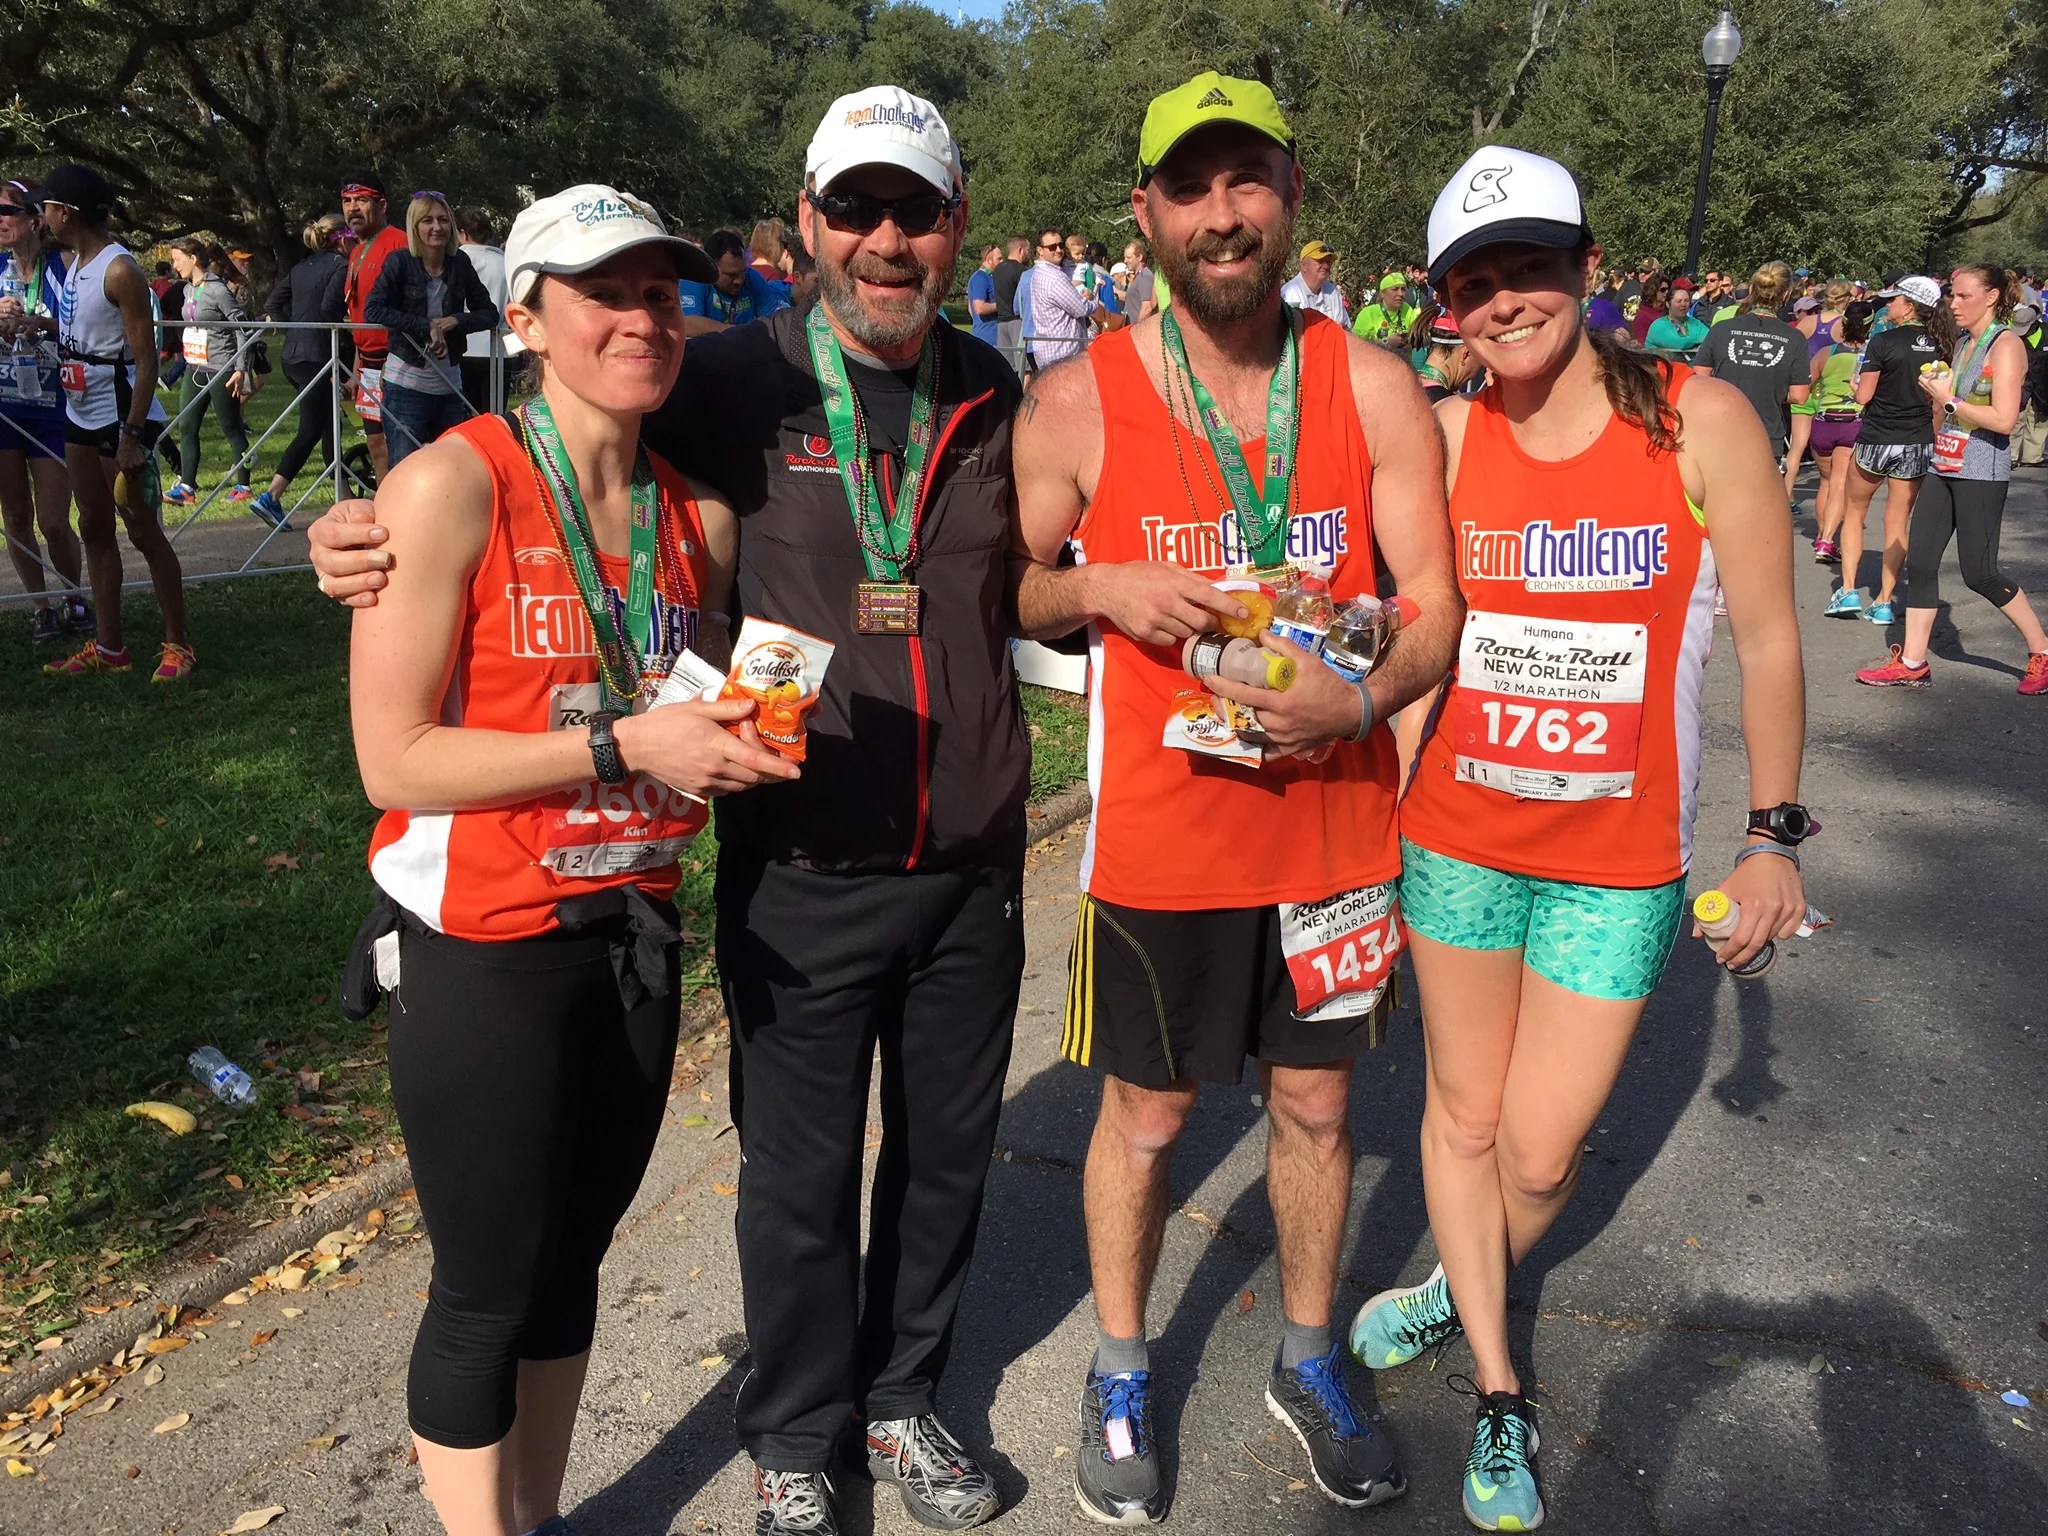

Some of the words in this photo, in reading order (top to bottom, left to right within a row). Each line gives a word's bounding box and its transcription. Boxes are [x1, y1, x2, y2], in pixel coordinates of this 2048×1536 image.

[1197, 98, 1233, 110] adidas
[572, 202, 593, 214] The
[577, 199, 627, 222] Ave
[587, 210, 644, 226] Marathon
[1743, 331, 1771, 339] BOURBON
[1771, 334, 1790, 344] CHASE
[1212, 432, 1242, 468] Half
[789, 465, 826, 473] MARATHON
[1462, 520, 1666, 588] TeamChallenge
[1526, 580, 1575, 591] CROHN'S
[1576, 580, 1585, 590] &
[1587, 578, 1630, 590] COLITIS
[746, 658, 801, 677] Goldfish
[1484, 658, 1523, 675] NEW
[1529, 664, 1617, 682] ORLEANS
[1494, 680, 1510, 692] 1/2
[1515, 685, 1600, 699] MARATHON
[1482, 701, 1609, 755] 1762
[1515, 788, 1542, 797] FEBRUARY
[624, 826, 648, 837] Kim
[571, 855, 583, 869] 2
[1302, 908, 1337, 931] NEW
[1316, 930, 1331, 944] 1/2
[1311, 915, 1400, 994] 1434
